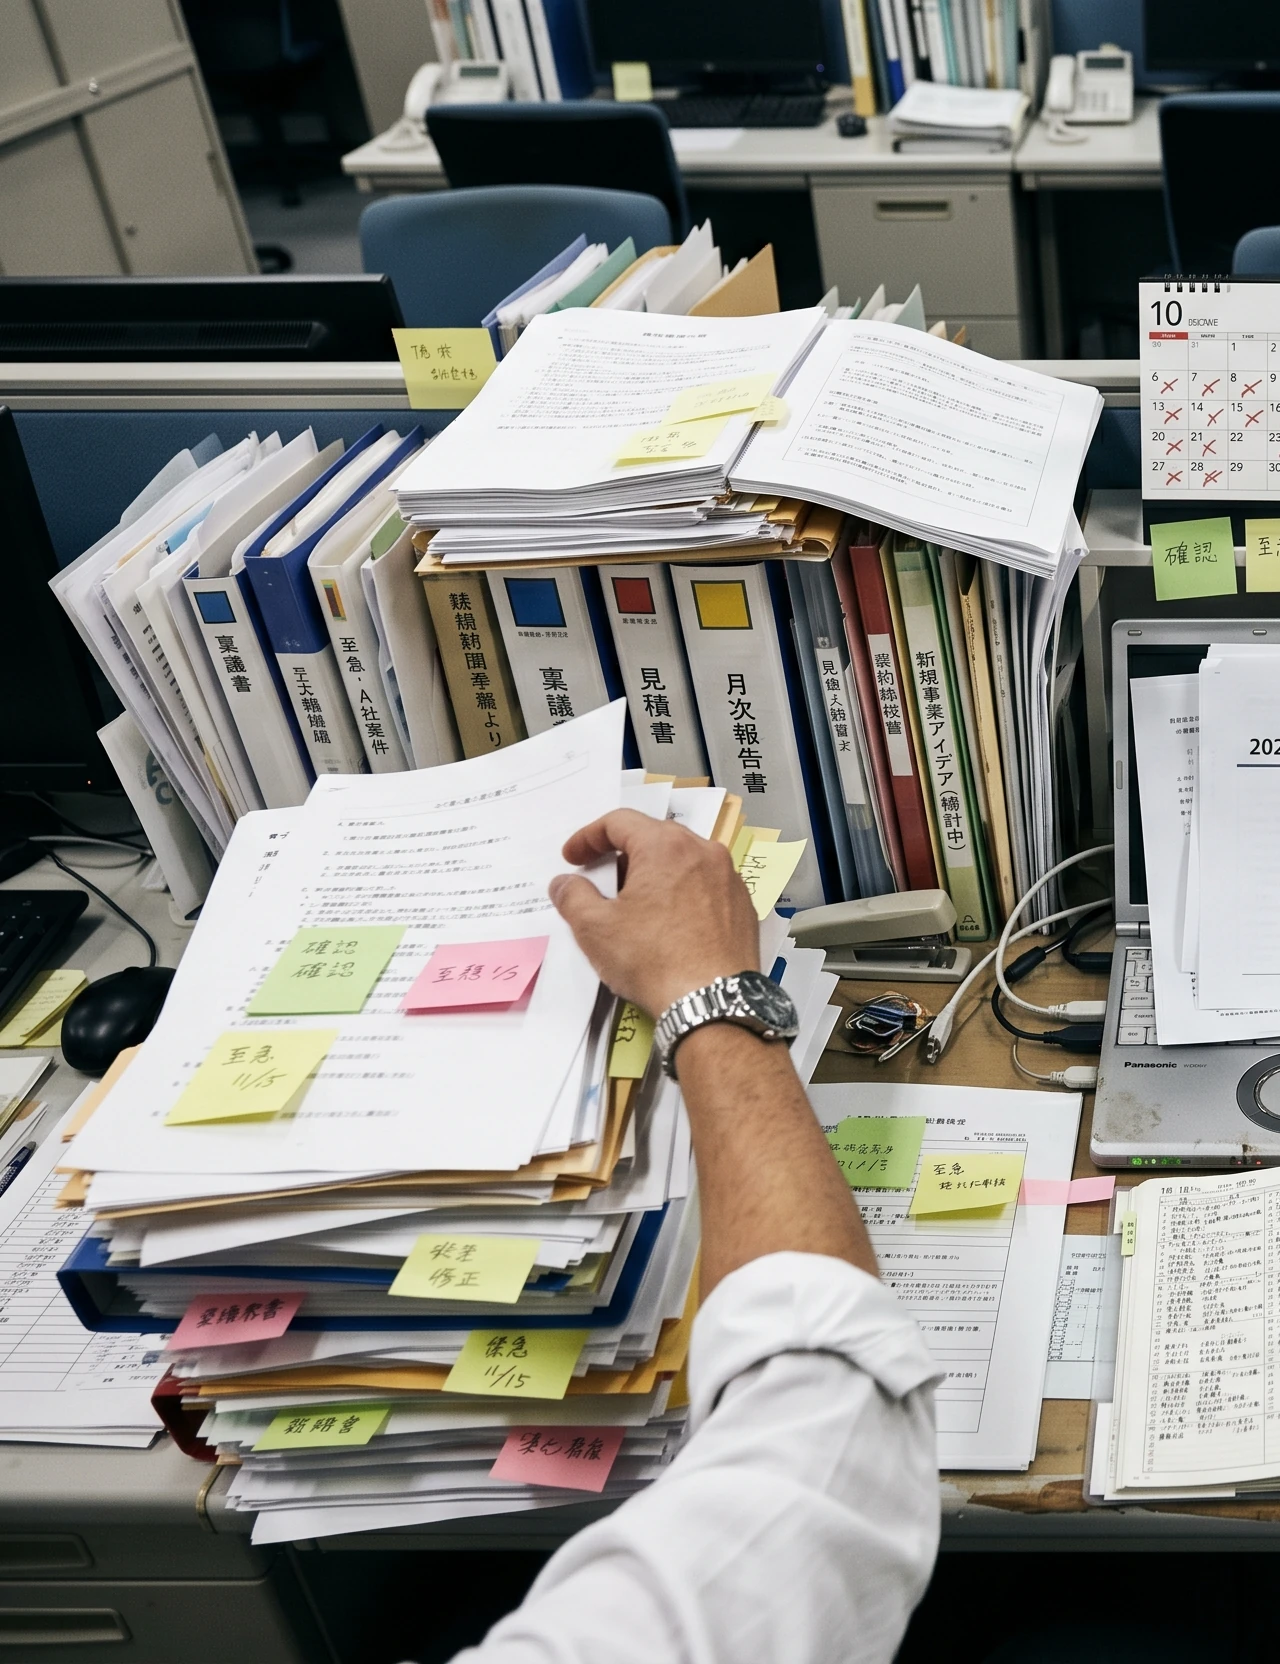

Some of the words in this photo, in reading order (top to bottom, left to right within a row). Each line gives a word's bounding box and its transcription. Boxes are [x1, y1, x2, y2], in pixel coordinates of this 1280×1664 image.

[1150, 300, 1183, 327] 10
[1230, 342, 1237, 352] 1
[1269, 342, 1278, 353] 2
[1151, 371, 1159, 382] 6
[1191, 372, 1198, 383] 7
[1230, 372, 1237, 383] 8
[1269, 373, 1277, 384] 9
[1152, 401, 1165, 411] 13
[1191, 402, 1204, 412] 14
[1231, 402, 1244, 413] 15
[1151, 431, 1166, 442] 20
[1190, 431, 1203, 442] 21
[1230, 432, 1244, 442] 22
[1151, 461, 1165, 471] 27
[1190, 461, 1204, 472] 28
[1230, 462, 1244, 472] 29
[1164, 541, 1218, 566] 確認
[539, 667, 575, 727] 稟議
[640, 667, 676, 744] 見積書
[727, 673, 768, 795] 月次報告書
[1124, 1061, 1178, 1069] Panasonic
